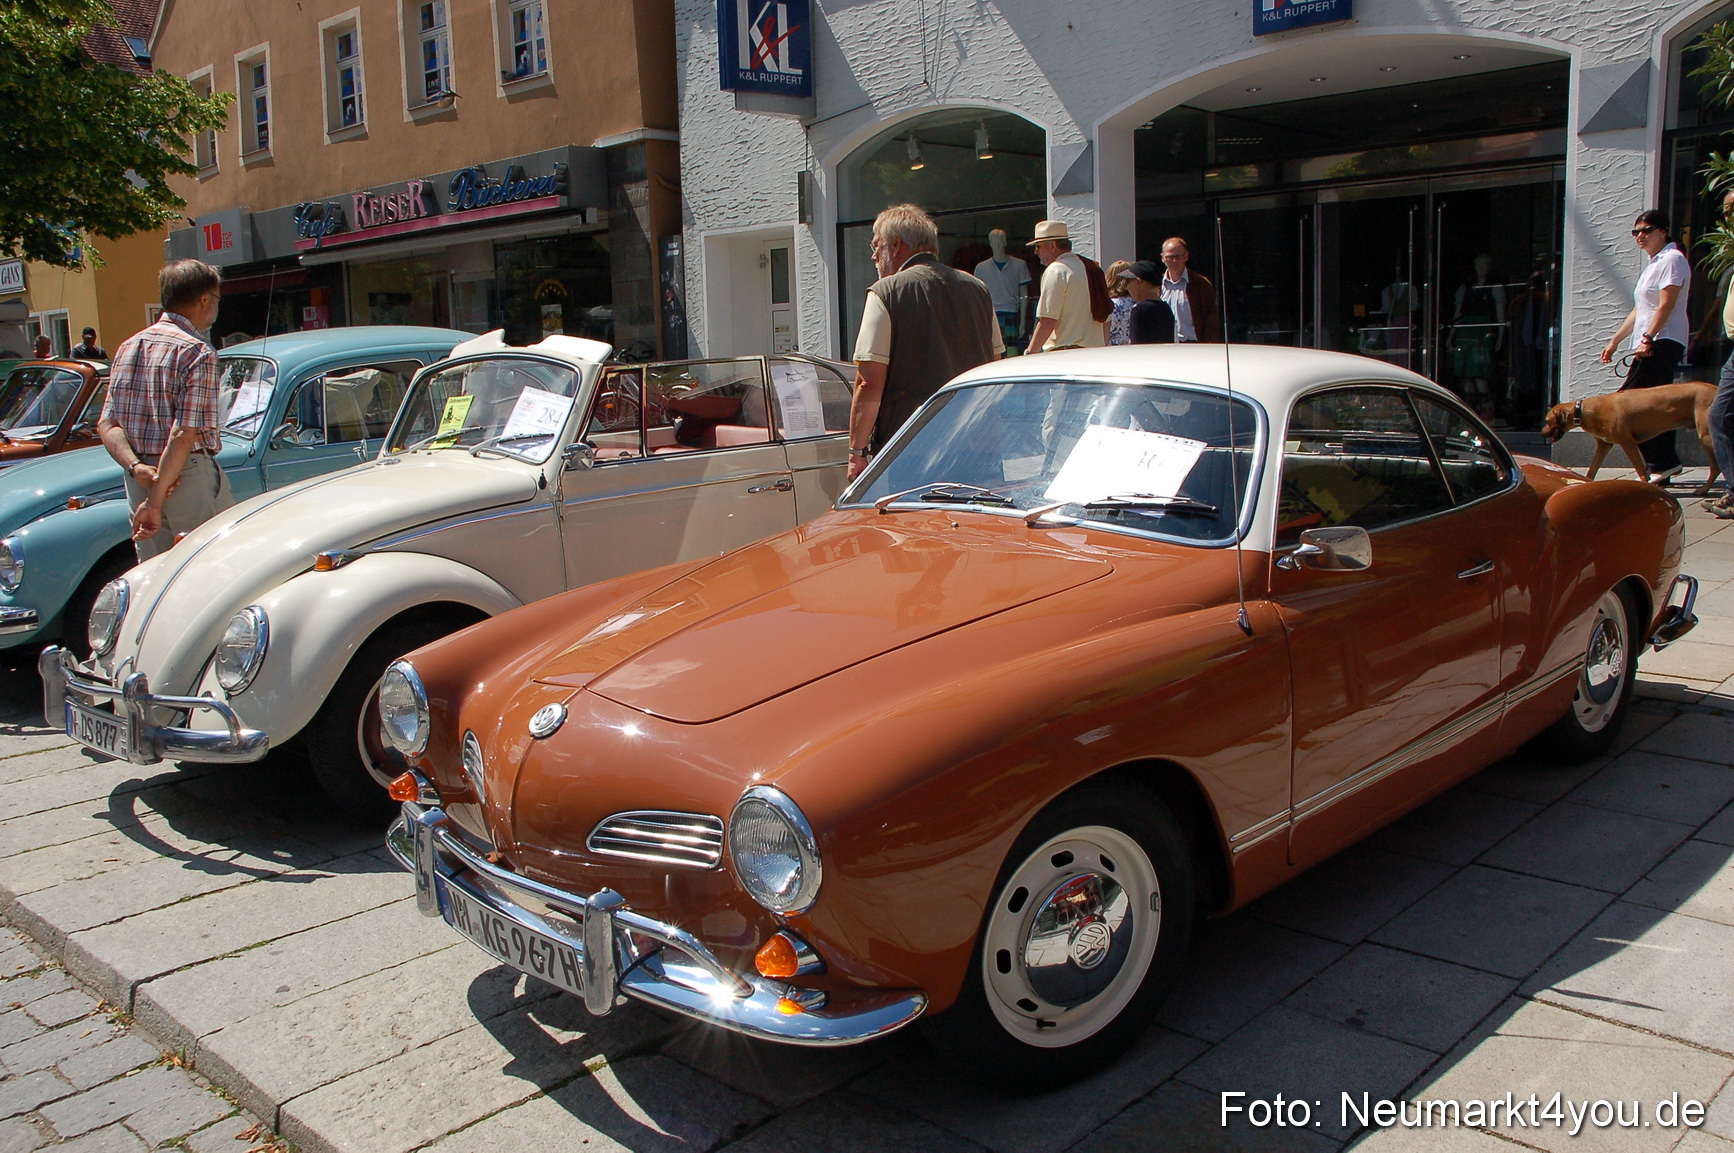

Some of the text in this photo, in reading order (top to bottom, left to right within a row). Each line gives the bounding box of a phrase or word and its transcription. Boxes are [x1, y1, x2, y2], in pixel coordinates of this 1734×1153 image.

[1262, 11, 1281, 22] K&L
[1284, 1, 1336, 18] RUPPERT
[739, 71, 802, 85] K&L RUPPERT
[353, 180, 428, 228] REISER
[448, 162, 560, 211] Bäckerei
[203, 223, 222, 251] 10
[222, 232, 232, 240] TOP
[223, 240, 233, 248] TEN
[537, 407, 563, 427] 284
[96, 720, 117, 751] 877
[479, 910, 511, 959] KG
[512, 928, 582, 991] 967H
